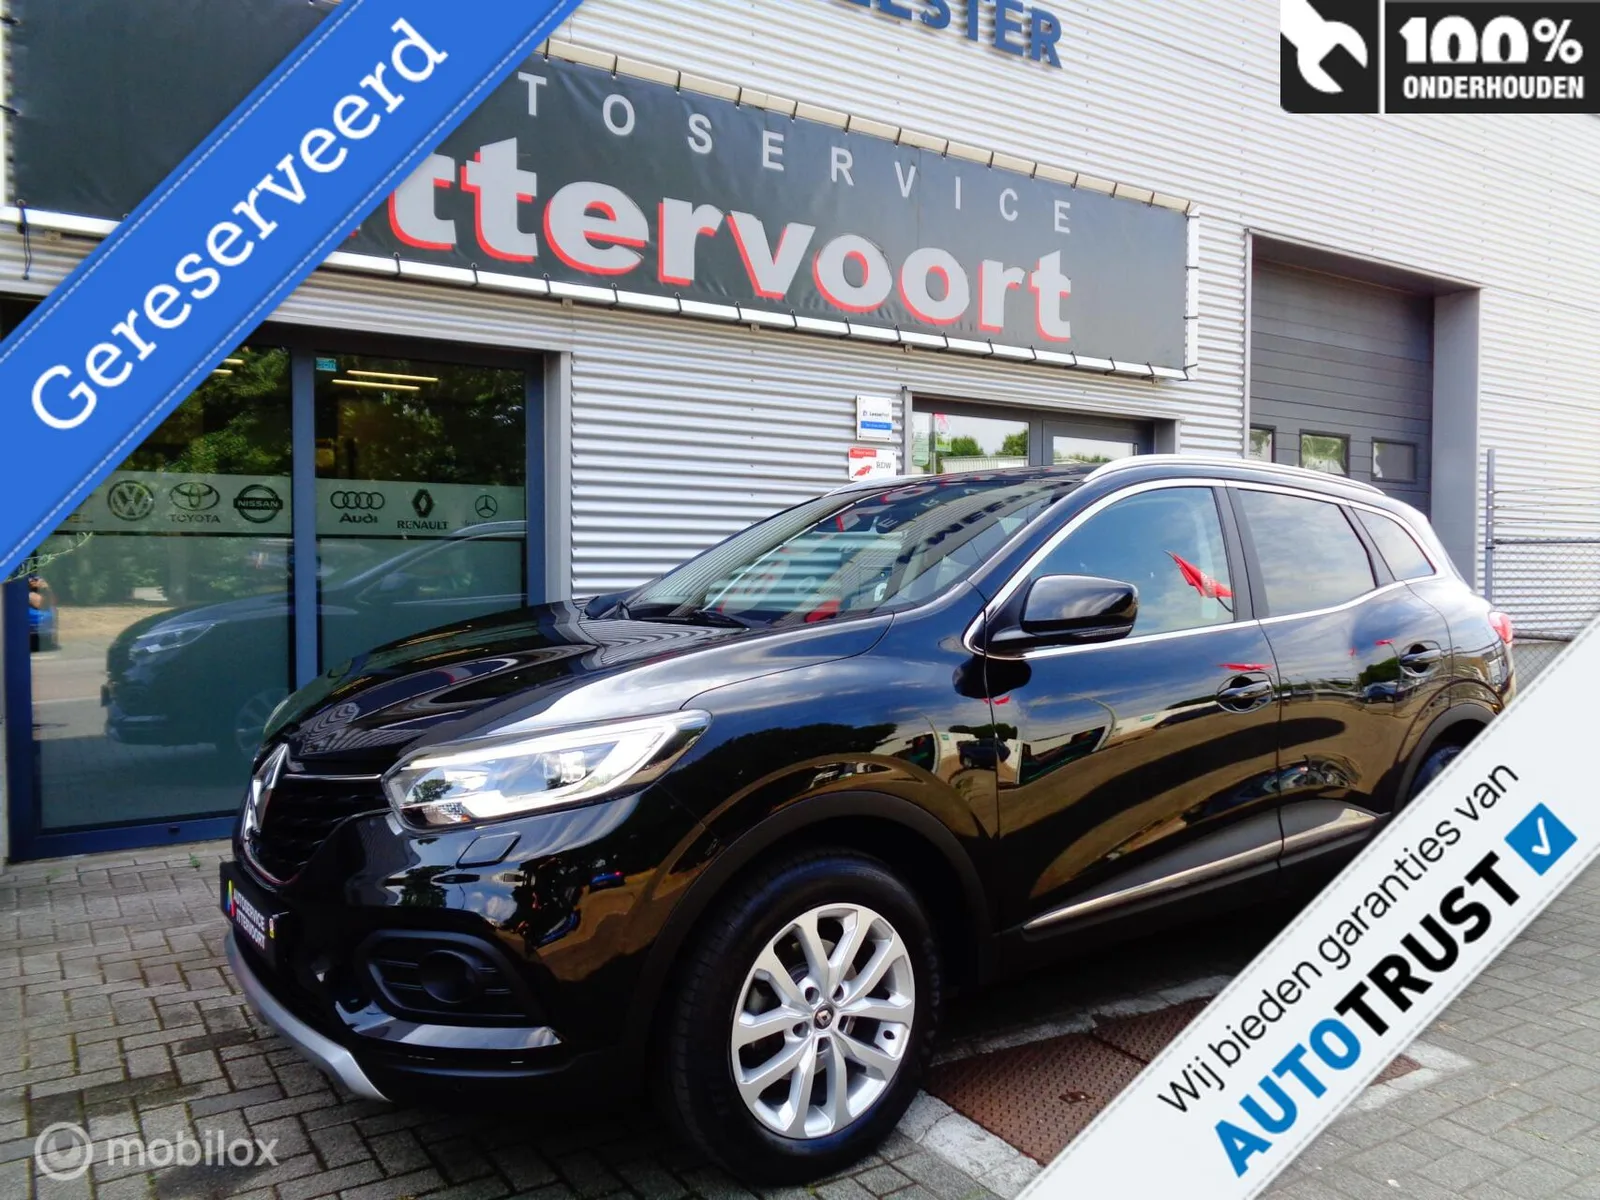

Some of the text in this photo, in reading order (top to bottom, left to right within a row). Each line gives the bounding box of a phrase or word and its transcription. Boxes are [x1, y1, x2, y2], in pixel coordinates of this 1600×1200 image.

[517, 72, 1072, 235] TOSERVICE
[350, 137, 1072, 342] ttervoort
[876, 461, 892, 469] RDW
[237, 499, 280, 508] NISSAN
[168, 513, 220, 524] TOYOTA
[339, 513, 378, 524] Audi
[397, 520, 448, 531] RENAULT
